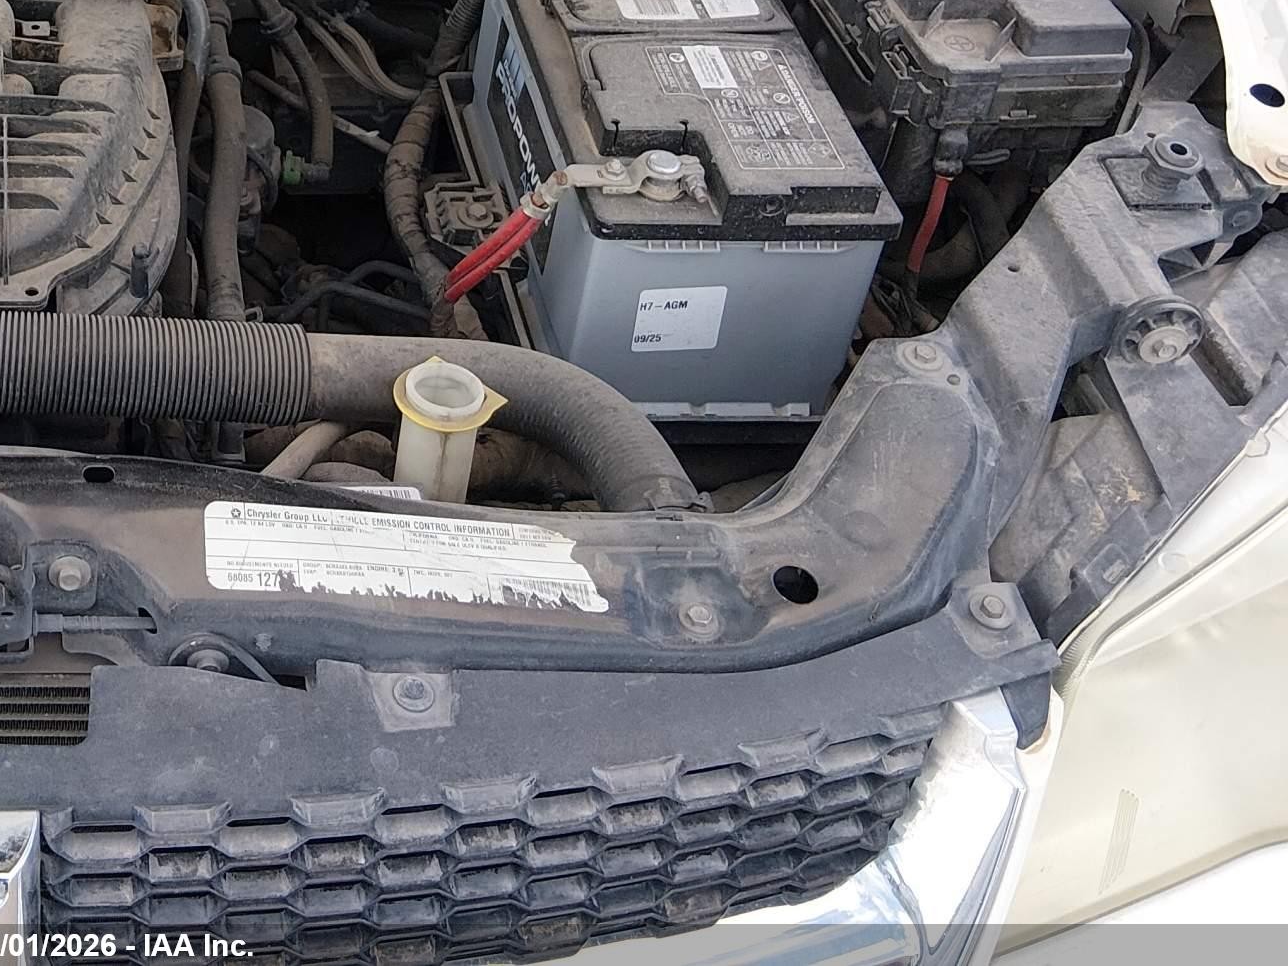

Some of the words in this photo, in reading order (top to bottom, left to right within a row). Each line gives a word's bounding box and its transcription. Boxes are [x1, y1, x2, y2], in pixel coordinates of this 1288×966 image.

[496, 60, 551, 226] PROPOW
[634, 334, 662, 344] 09/25
[247, 508, 282, 520] Chrysler
[284, 510, 310, 522] Group
[371, 517, 411, 529] EMISSION
[413, 520, 451, 532] CONTROL
[453, 524, 511, 537] INFORMATION
